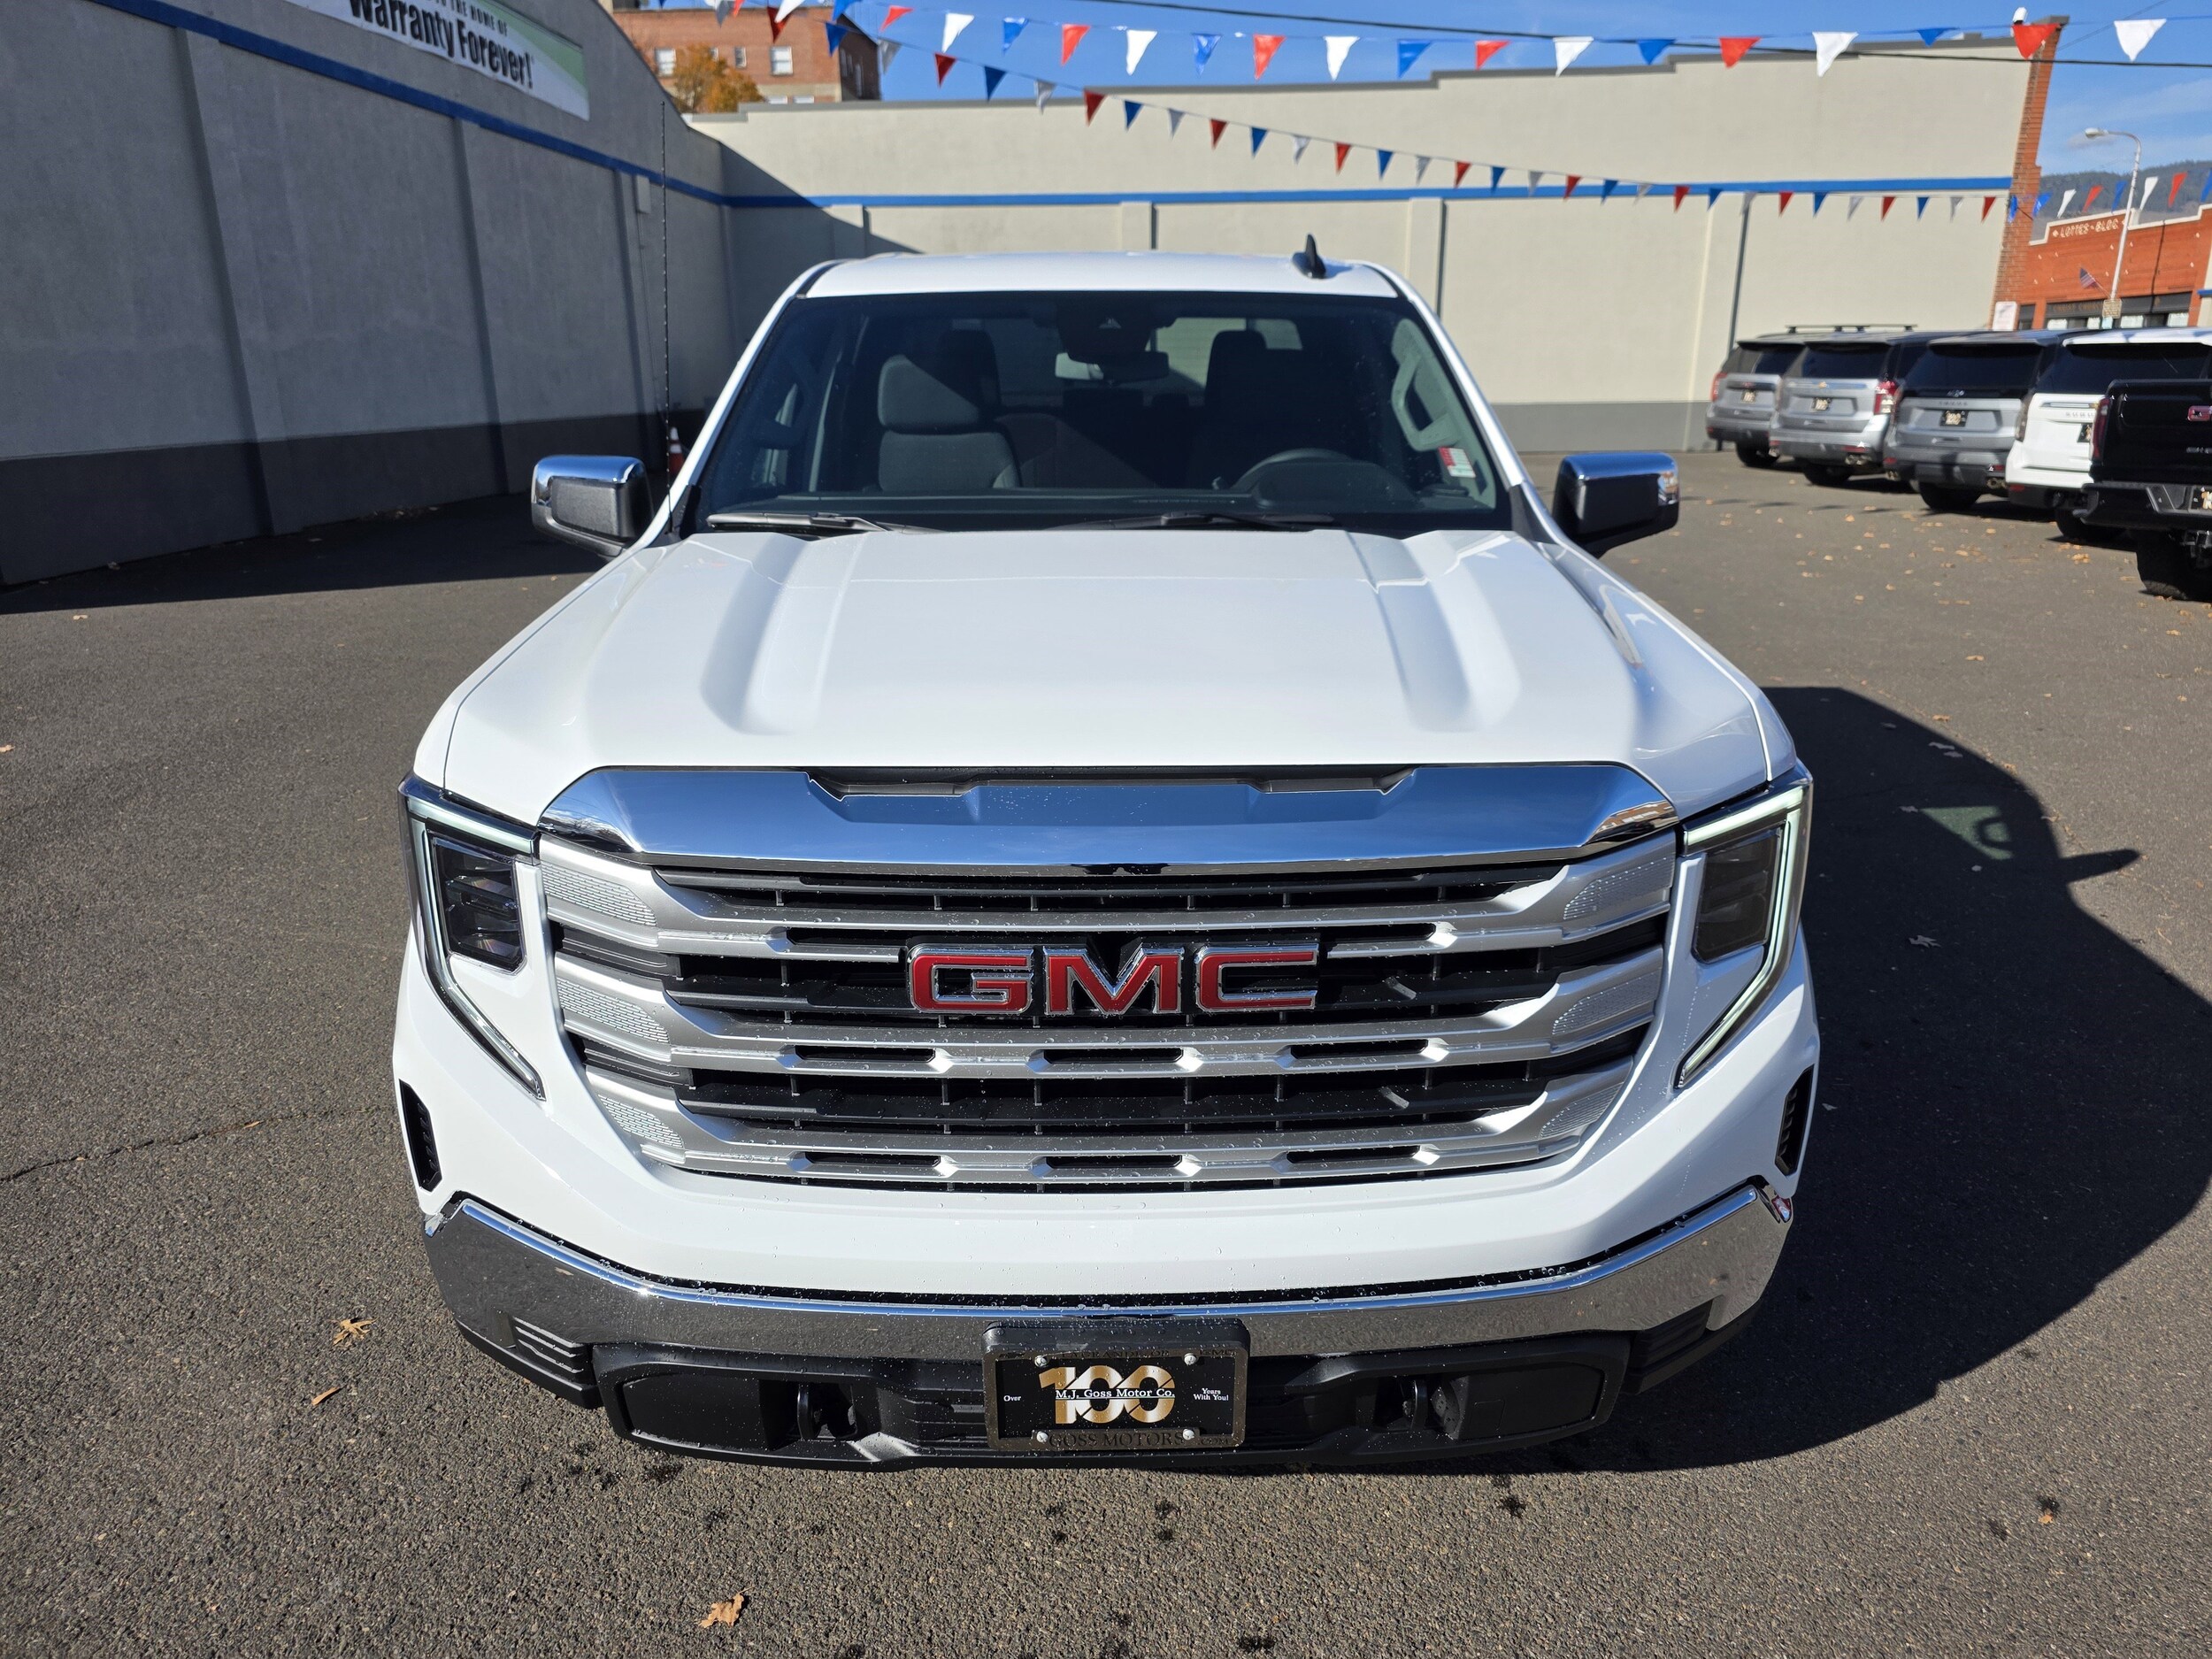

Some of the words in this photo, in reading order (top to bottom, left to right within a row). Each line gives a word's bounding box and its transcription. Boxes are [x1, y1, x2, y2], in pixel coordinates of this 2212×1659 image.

[471, 5, 495, 30] HOME
[498, 19, 508, 36] OF
[456, 18, 534, 89] Forever!
[908, 943, 1319, 1015] GMC
[1039, 1365, 1176, 1425] 100
[1056, 1390, 1079, 1399] M.J.
[1156, 1388, 1175, 1397] Co.
[1048, 1432, 1096, 1447] GOSS
[1101, 1432, 1184, 1447] MOTORS
